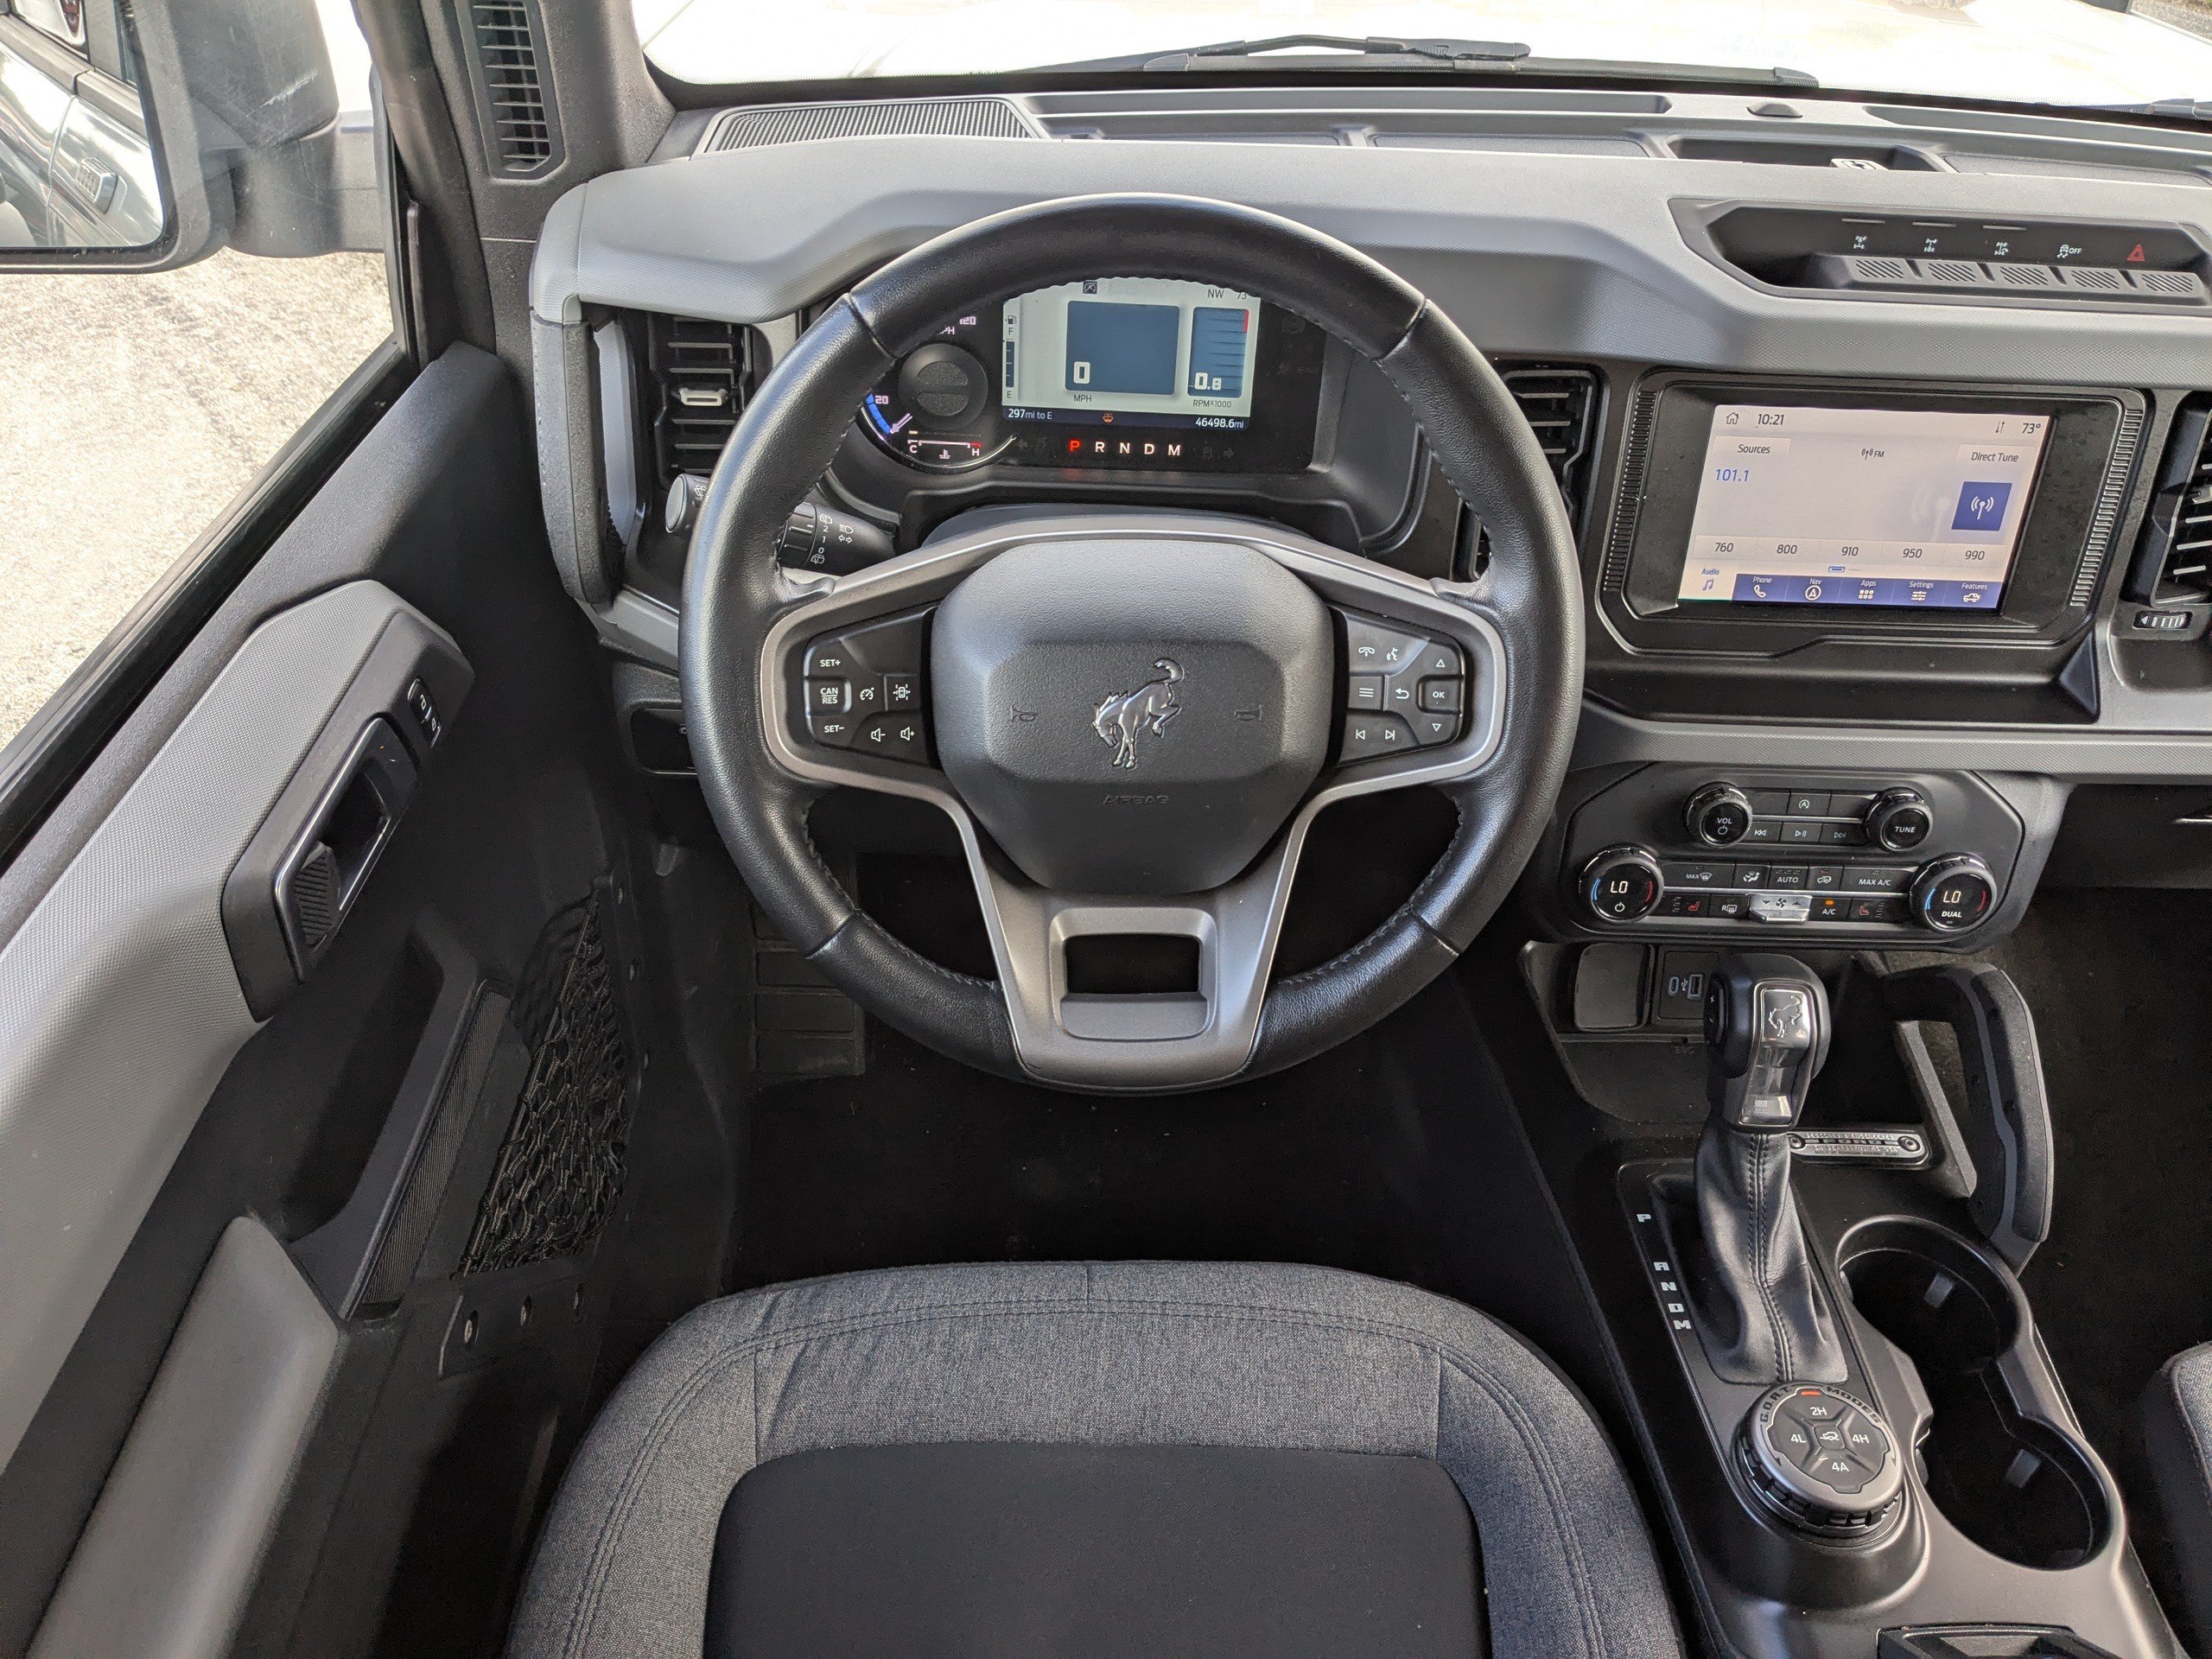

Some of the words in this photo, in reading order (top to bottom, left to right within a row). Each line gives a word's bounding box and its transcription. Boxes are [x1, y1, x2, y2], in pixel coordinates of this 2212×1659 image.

[1207, 289, 1224, 299] NW
[1073, 361, 1090, 384] 0
[1194, 372, 1222, 391] 0.8
[874, 395, 889, 405] 20
[1073, 394, 1092, 403] MPH
[1037, 411, 1046, 420] to
[1047, 411, 1052, 420] E
[1757, 413, 1784, 426] 10:21
[909, 444, 918, 454] C
[971, 448, 980, 457] H
[1070, 439, 1081, 452] P
[1095, 441, 1105, 453] R
[1119, 442, 1130, 454] N
[1144, 443, 1155, 455] D
[1167, 444, 1181, 456] M
[1738, 443, 1771, 454] Sources
[1873, 450, 1885, 459] FM
[1971, 451, 1995, 462] Direct
[1998, 452, 2019, 463] Tune
[1715, 468, 1750, 482] 101.1
[823, 524, 829, 533] 2
[1714, 542, 1734, 553] 760
[1777, 544, 1798, 555] 800
[1841, 546, 1859, 557] 910
[1903, 548, 1923, 559] 950
[1965, 550, 1986, 561] 990
[1860, 580, 1877, 588] Apps
[1908, 581, 1935, 589] Settings
[820, 658, 842, 668] SET+
[1717, 817, 1732, 825] VOL
[1610, 880, 1629, 893] LO
[1942, 890, 1962, 904] LO
[1636, 1213, 1652, 1223] P
[1661, 1281, 1677, 1292] N
[1668, 1303, 1685, 1313] D
[1673, 1319, 1692, 1330] M
[1826, 1385, 1883, 1424] MODES
[1809, 1406, 1827, 1416] 2H
[1790, 1433, 1807, 1444] 4L
[1852, 1433, 1870, 1444] 4H
[1831, 1461, 1849, 1473] 4A
